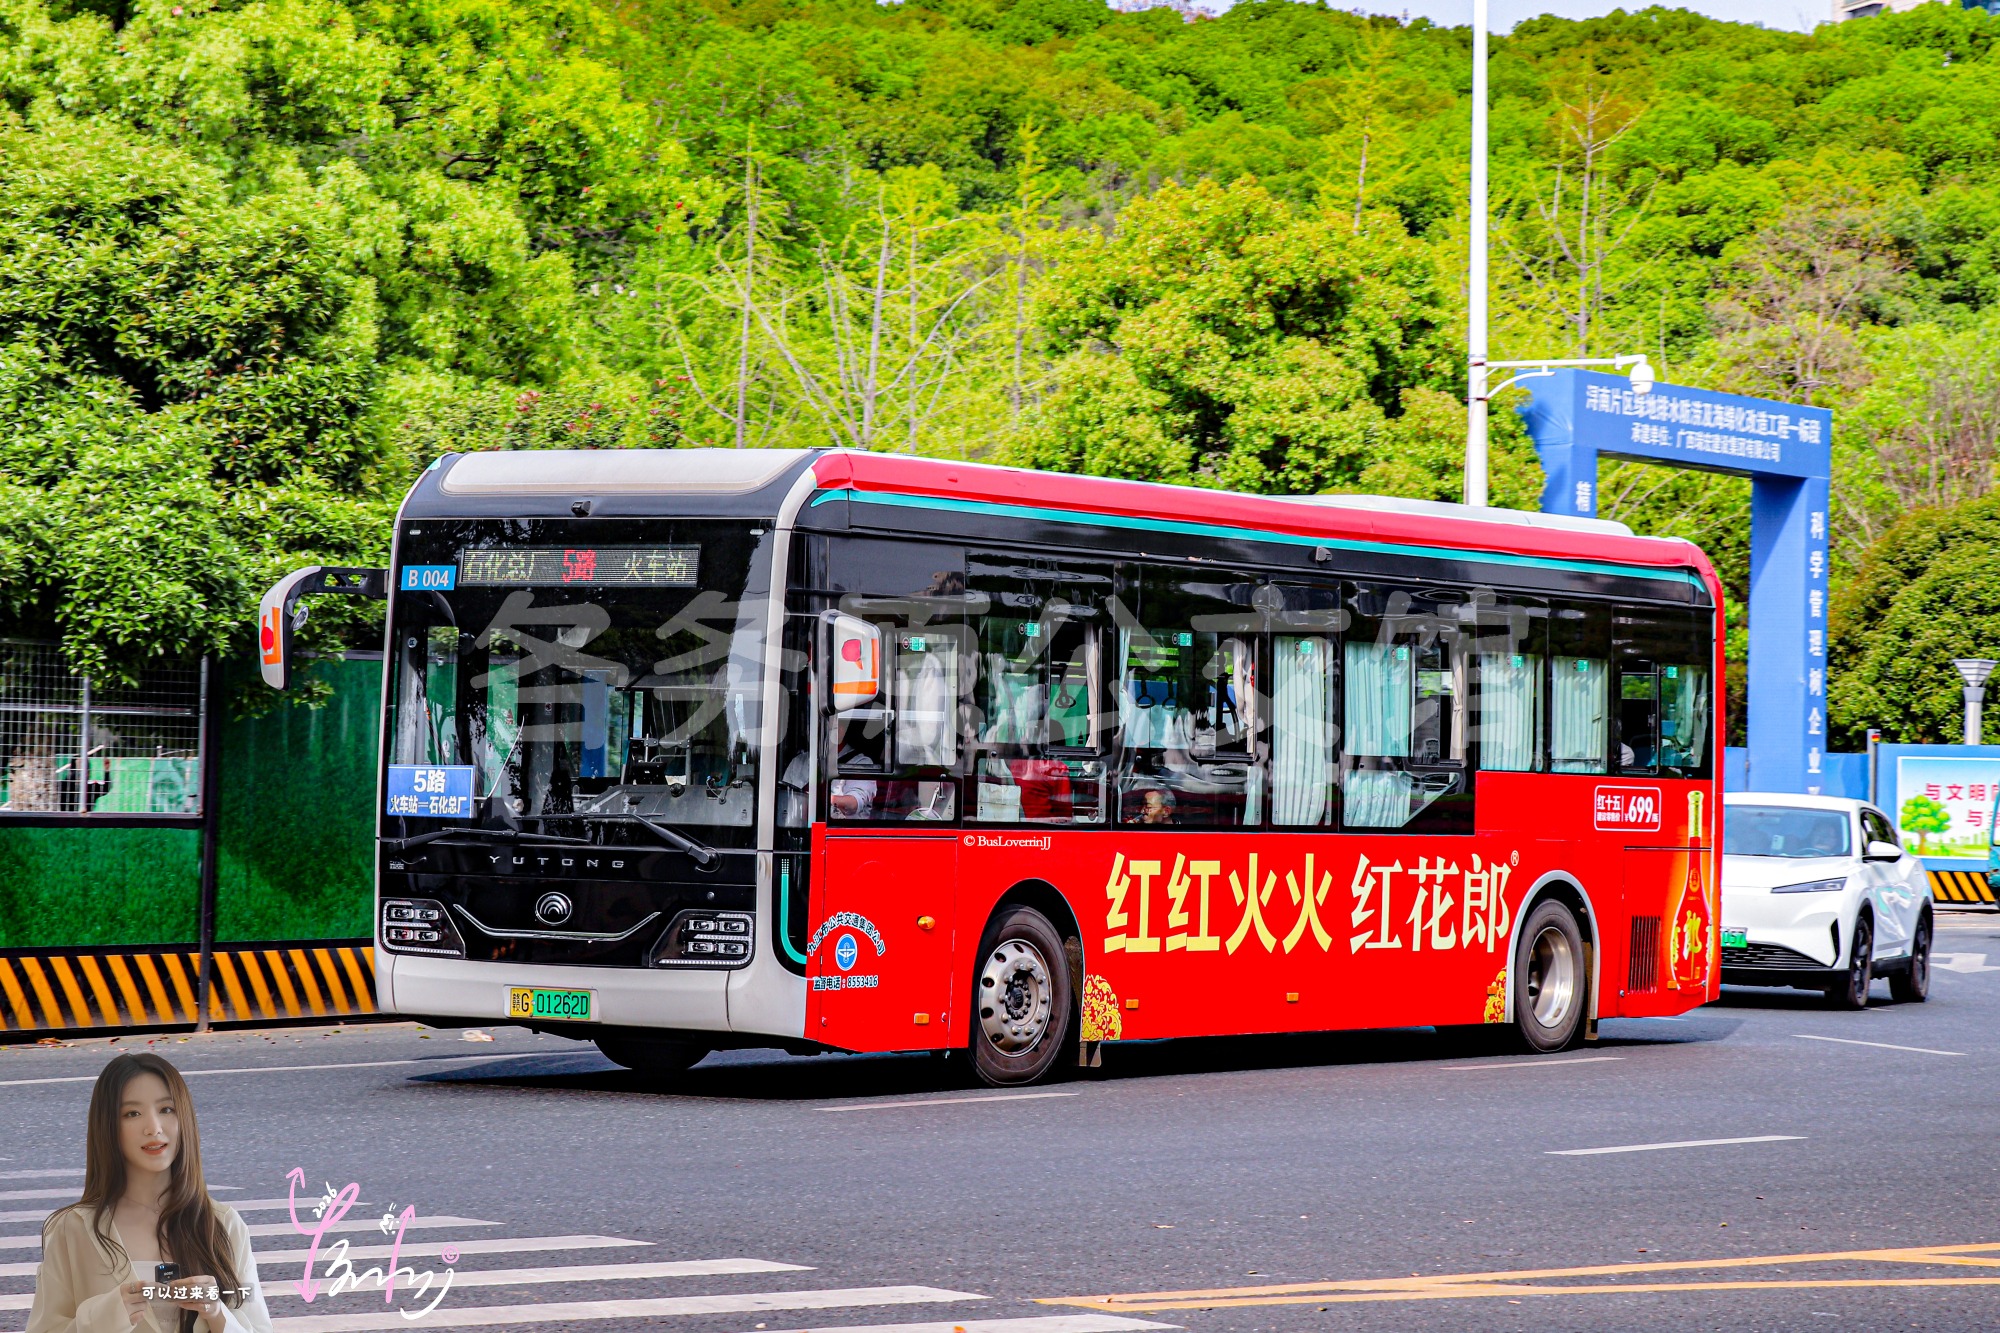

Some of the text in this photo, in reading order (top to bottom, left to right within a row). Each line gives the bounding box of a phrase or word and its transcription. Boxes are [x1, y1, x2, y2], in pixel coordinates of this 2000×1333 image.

[464, 550, 550, 580] 石化总厂
[562, 549, 597, 582] 5路
[622, 551, 687, 582] 火车站
[408, 570, 449, 588] B 004
[413, 769, 446, 793] 5路
[1597, 794, 1621, 811] 红十五
[489, 855, 625, 868] YUTONG
[1104, 852, 1333, 956] 红红火火
